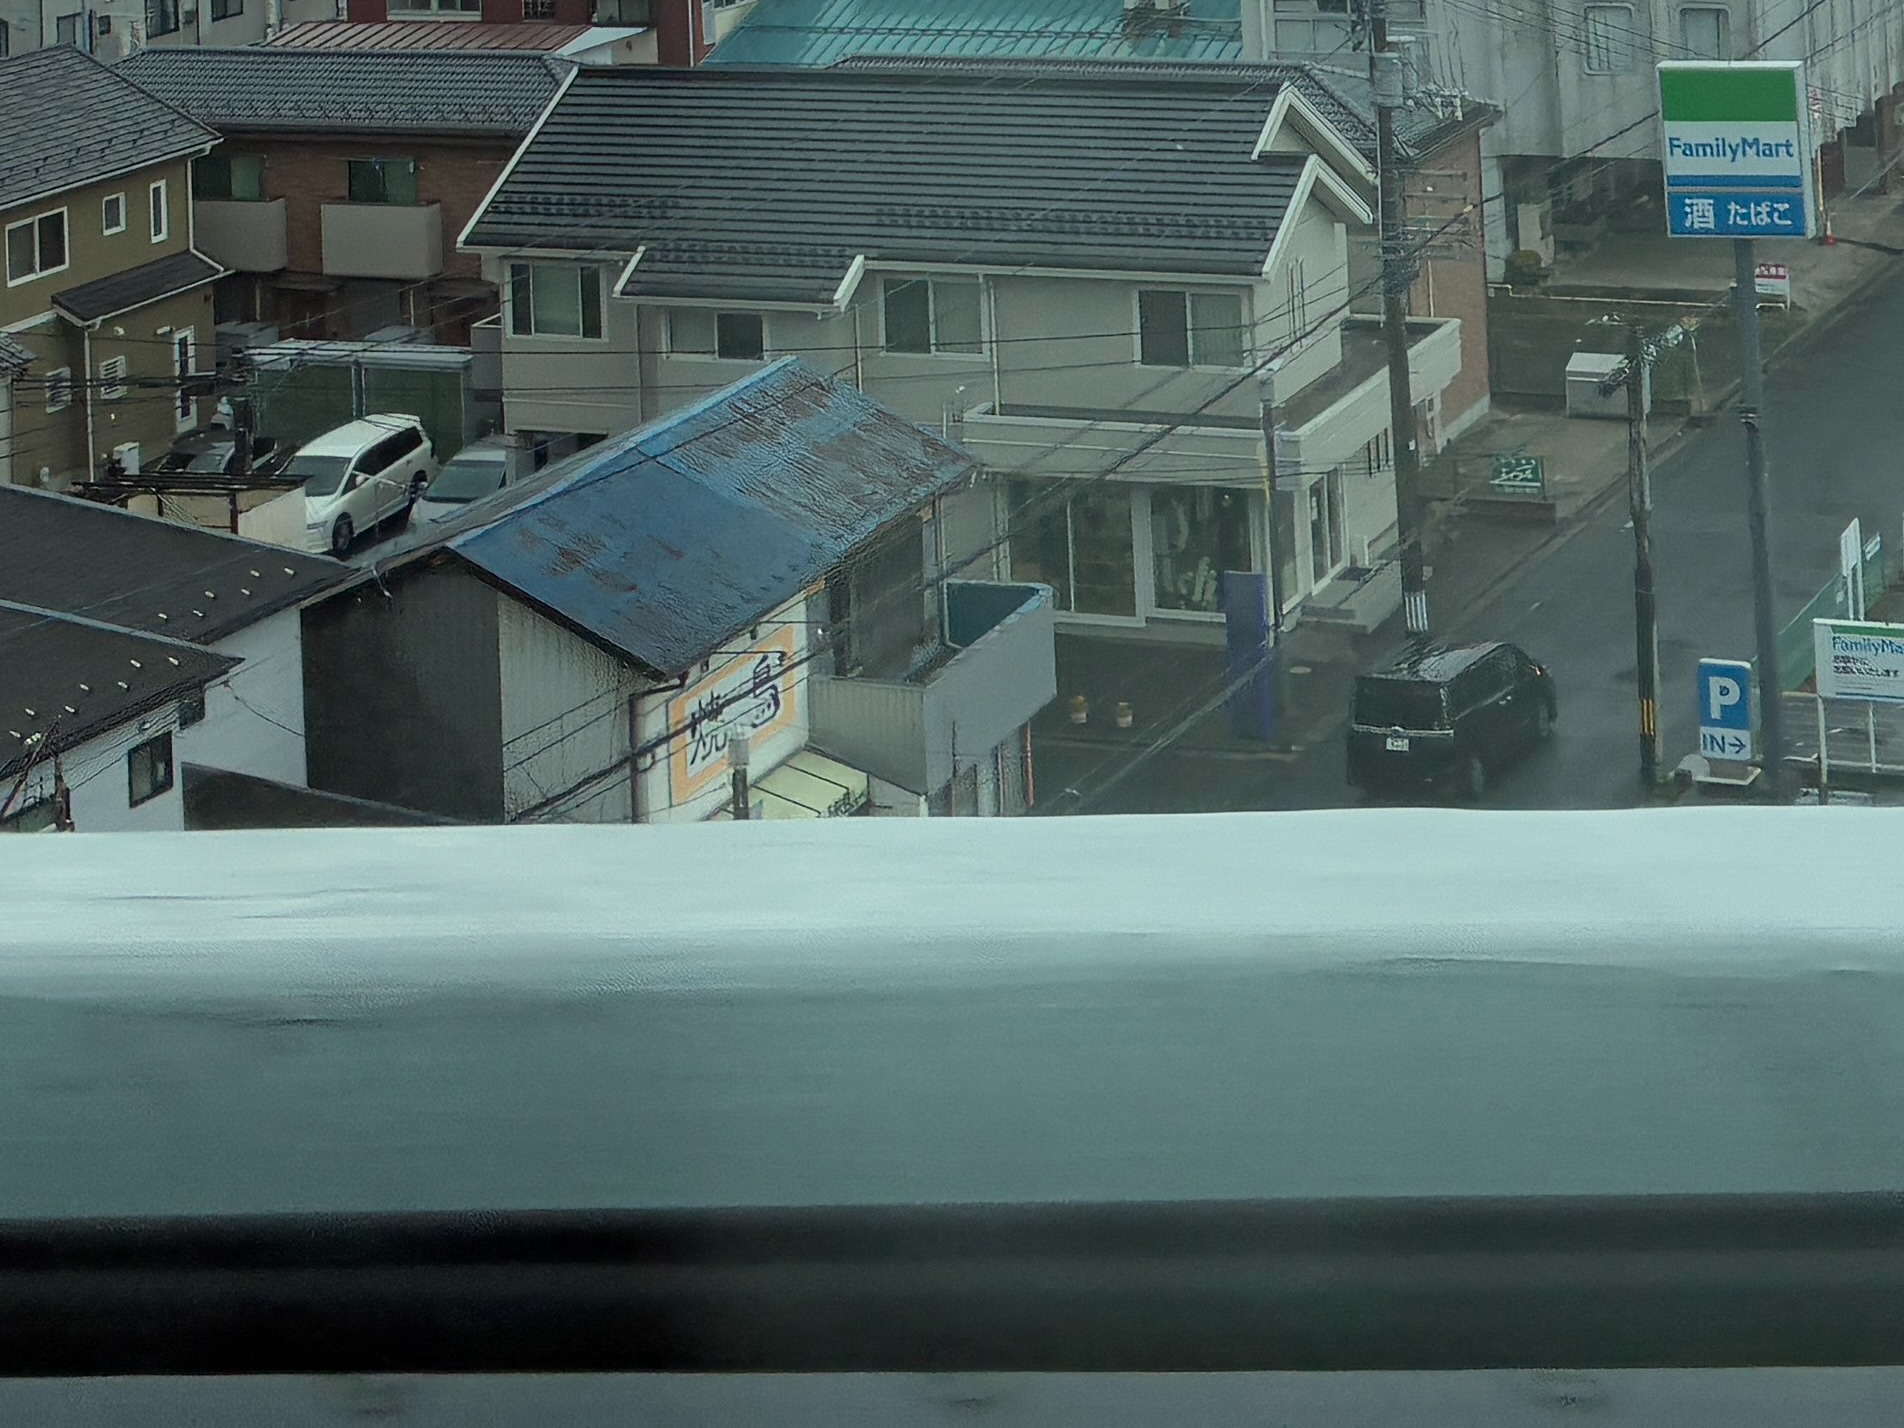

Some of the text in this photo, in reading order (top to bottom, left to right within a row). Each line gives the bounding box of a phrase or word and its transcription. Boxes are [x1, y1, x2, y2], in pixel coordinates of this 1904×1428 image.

[1668, 137, 1794, 162] FamilyMart
[1684, 198, 1792, 229] 酒 たばこ
[1709, 676, 1741, 720] P
[1702, 732, 1726, 754] IN
